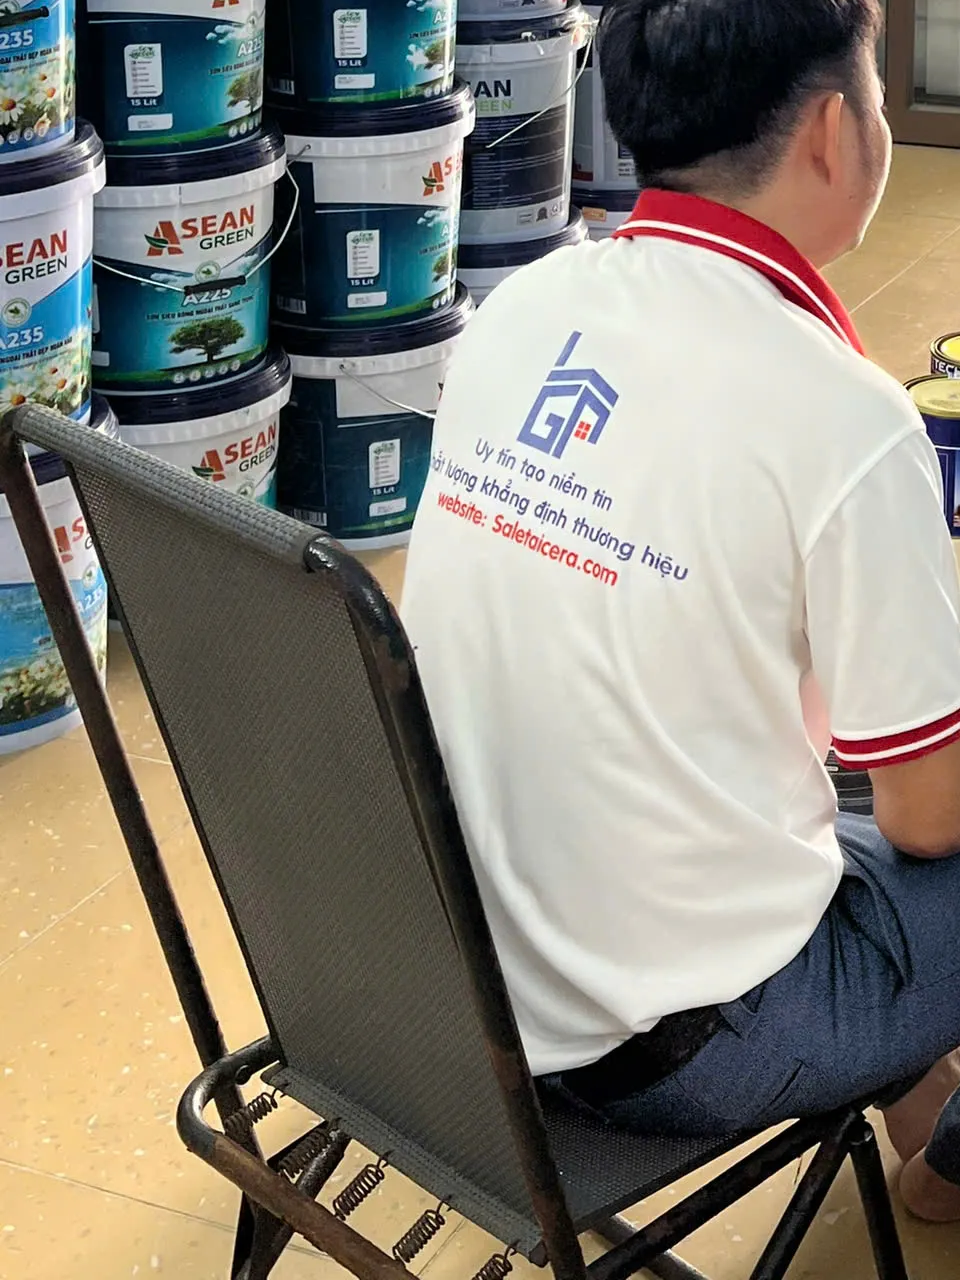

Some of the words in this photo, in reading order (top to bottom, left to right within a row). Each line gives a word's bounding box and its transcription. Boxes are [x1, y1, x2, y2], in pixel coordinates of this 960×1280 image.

[0, 29, 33, 50] 235
[0, 229, 68, 269] EAN
[144, 205, 255, 256] ASEAN
[199, 226, 255, 250] GREEN
[5, 255, 68, 285] GREEN
[198, 423, 277, 482] ASEAN
[239, 444, 277, 473] GREEN
[475, 437, 495, 463] Uy
[496, 448, 517, 470] tín
[519, 458, 546, 482] tạo
[548, 471, 588, 501] niềm
[592, 488, 613, 511] tin
[437, 491, 488, 527] website:
[491, 514, 619, 587] Saletaicera.com
[445, 460, 479, 493] lượng
[480, 475, 531, 516] khẳng
[534, 500, 568, 529] định
[572, 517, 636, 561] thương
[640, 544, 689, 581] hiệu
